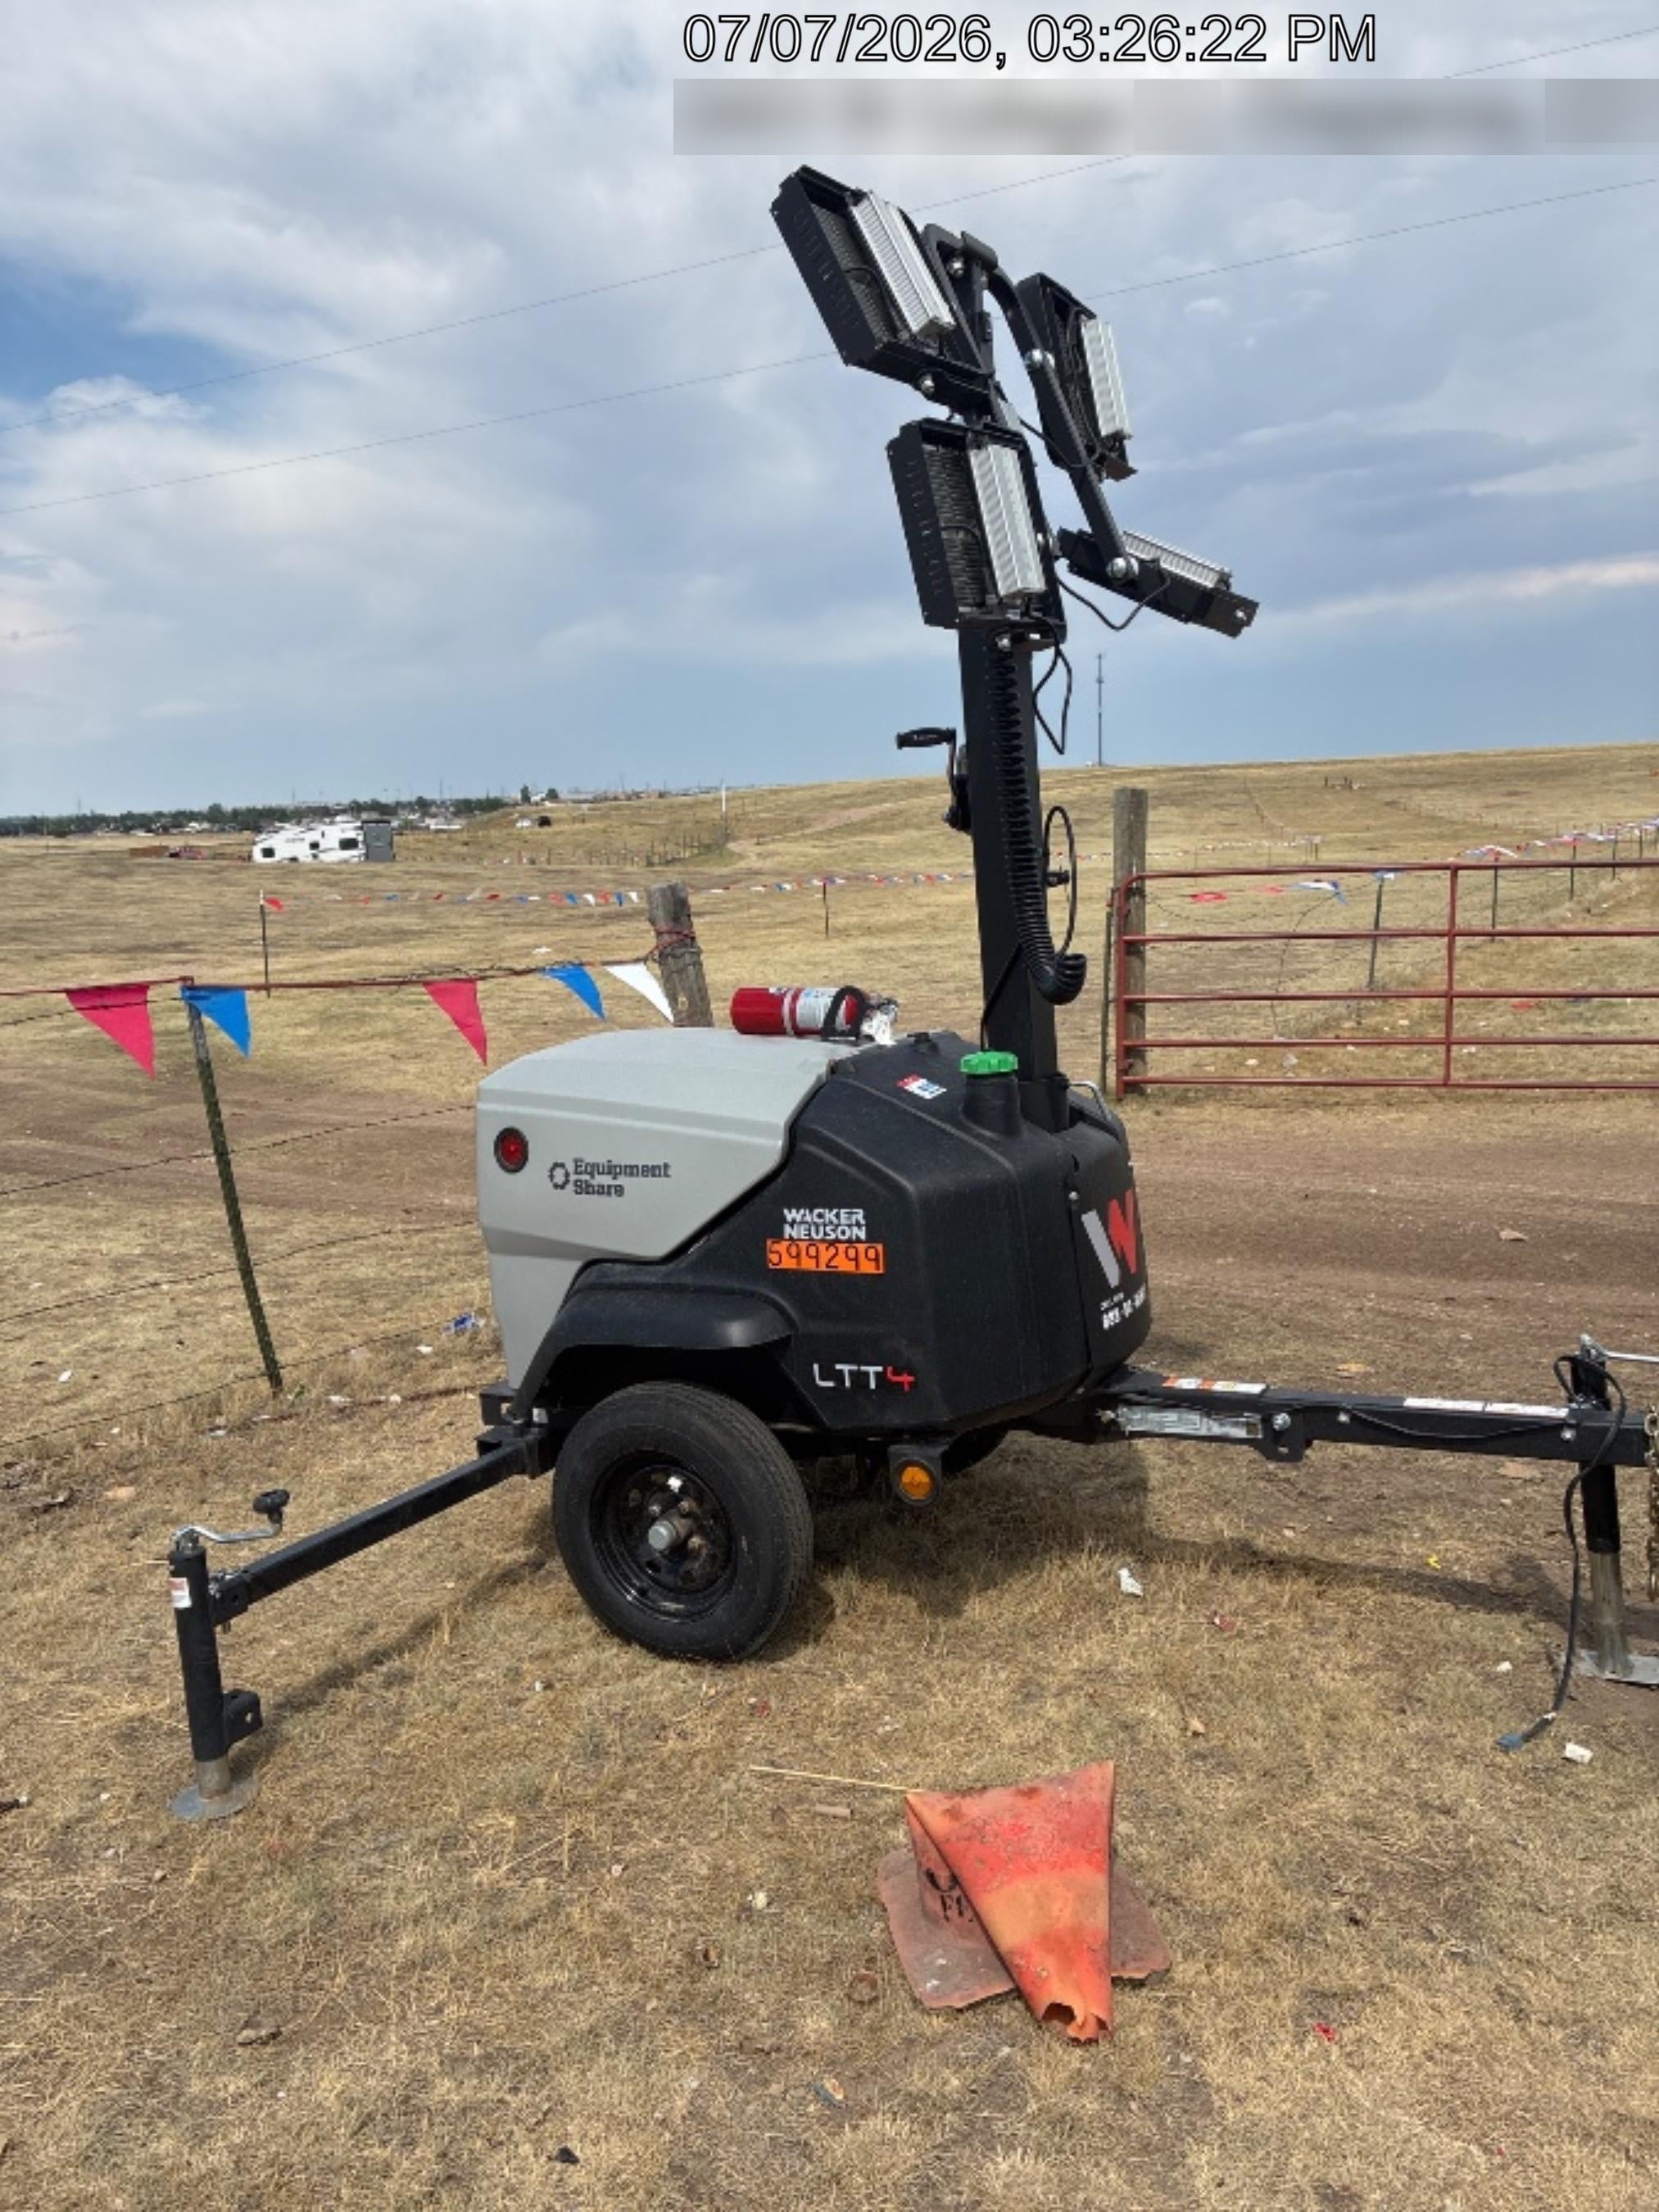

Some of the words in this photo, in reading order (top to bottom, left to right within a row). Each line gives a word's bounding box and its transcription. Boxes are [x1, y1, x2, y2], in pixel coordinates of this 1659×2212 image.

[573, 1158, 671, 1180] Equipment
[573, 1180, 624, 1197] Share
[782, 1208, 866, 1225] WACKER
[783, 1223, 866, 1240] NEUSON
[768, 1241, 881, 1271] 599299
[813, 1363, 915, 1392] LTT4
